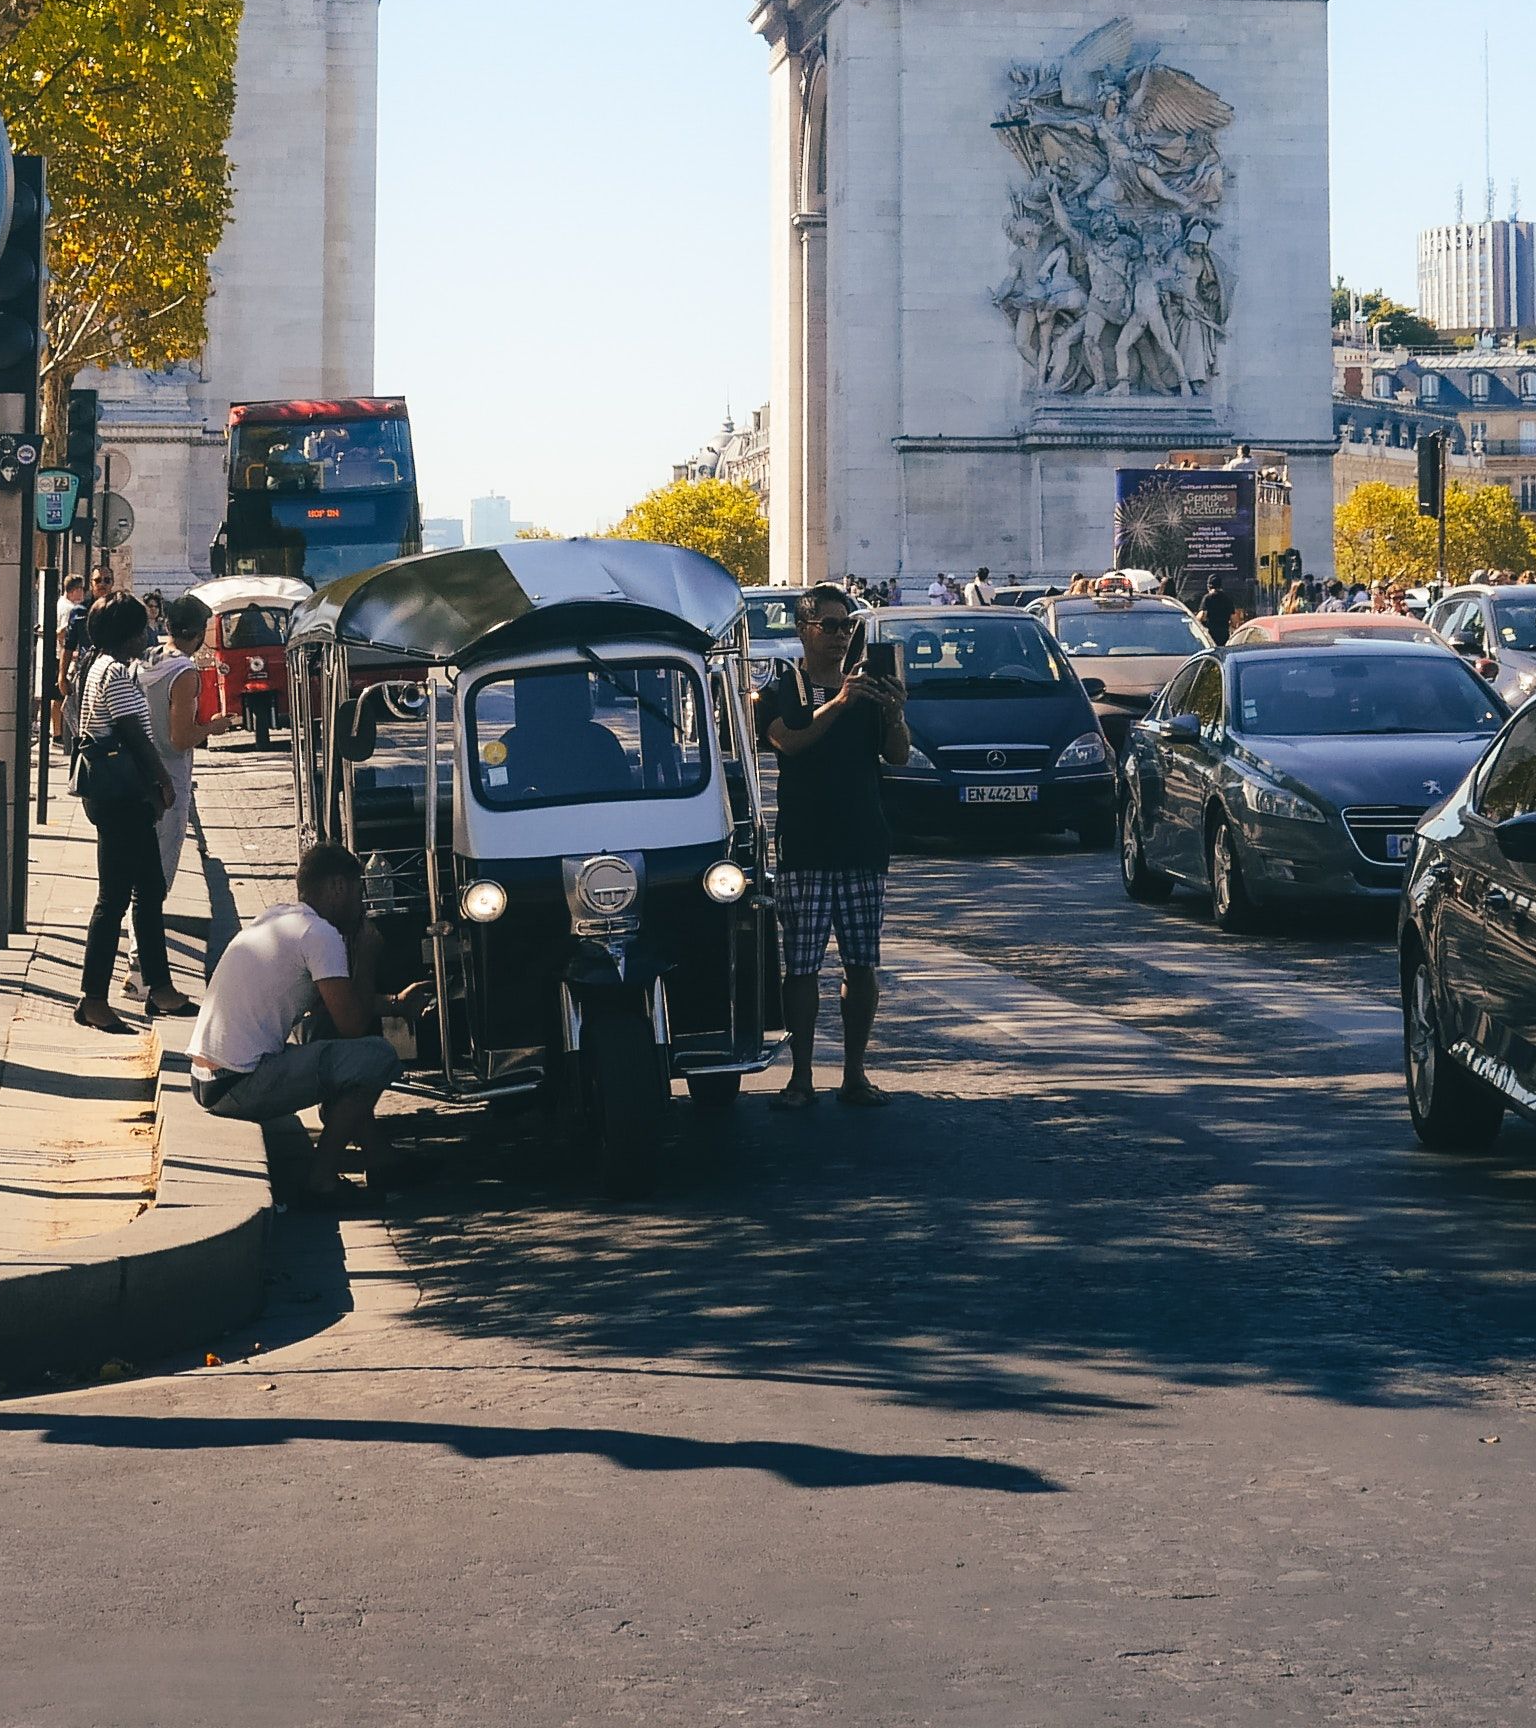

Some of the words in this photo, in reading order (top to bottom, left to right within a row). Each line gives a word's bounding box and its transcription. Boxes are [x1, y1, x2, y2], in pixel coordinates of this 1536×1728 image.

[1186, 491, 1229, 502] Grandes
[1184, 506, 1237, 515] Nocturnes
[967, 787, 1031, 801] EN-442-LX
